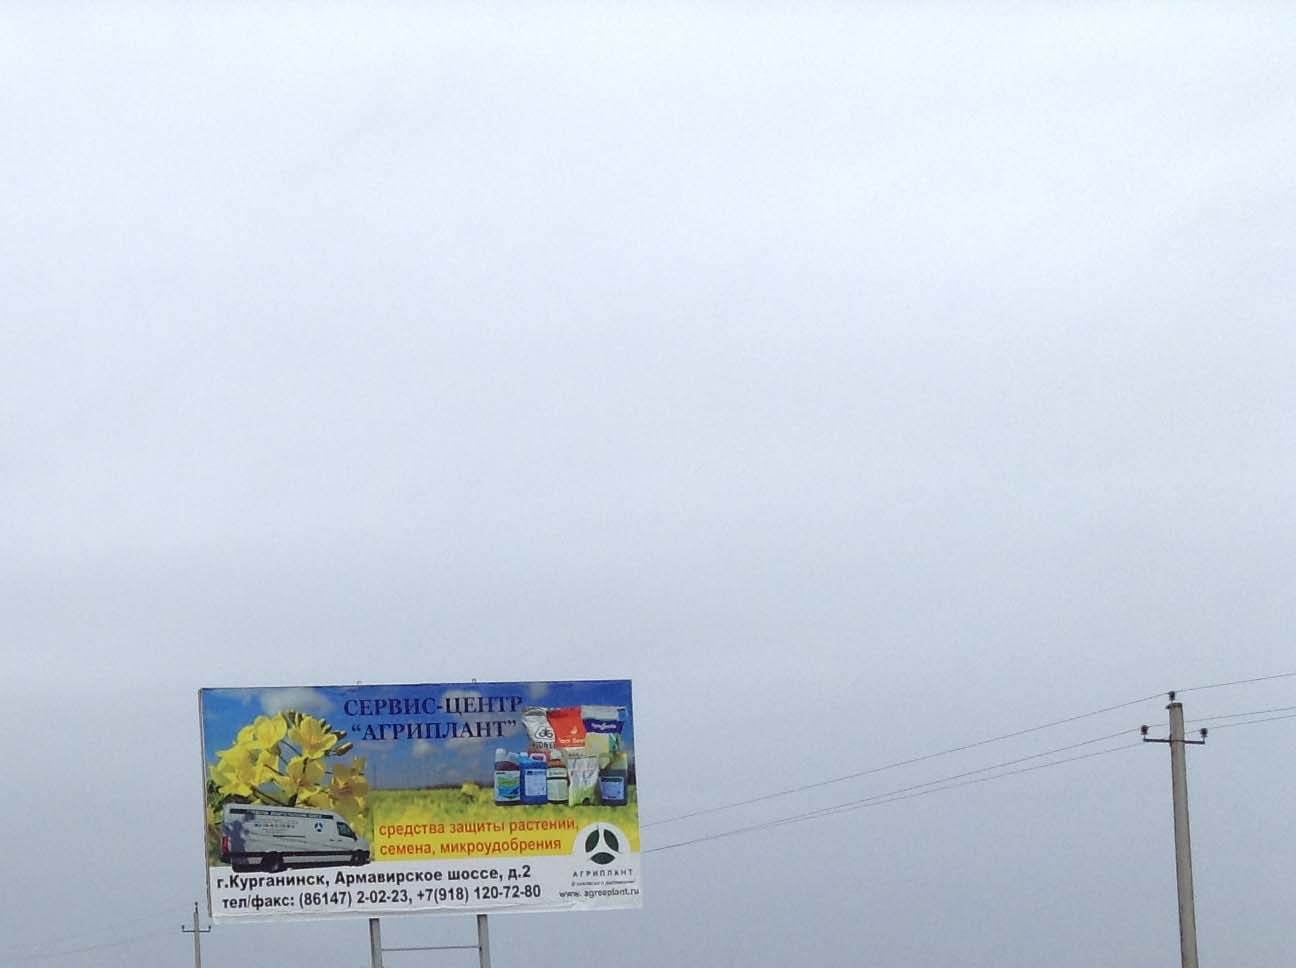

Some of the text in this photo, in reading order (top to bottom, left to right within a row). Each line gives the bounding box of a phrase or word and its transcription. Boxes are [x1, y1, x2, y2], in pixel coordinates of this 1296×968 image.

[344, 696, 523, 716] СЕРВИС-ЦЕНТР
[379, 817, 579, 838] средства защиты растений,
[380, 837, 561, 856] семена, микроудобрения
[335, 870, 443, 888] Армавирское
[448, 867, 503, 881] шоссе,
[507, 864, 531, 881] д.2
[572, 868, 633, 878] АГРИПЛАНТ
[223, 884, 541, 910] тел/факс: (86147) 2-02-23, +7(918) 120-72-80
